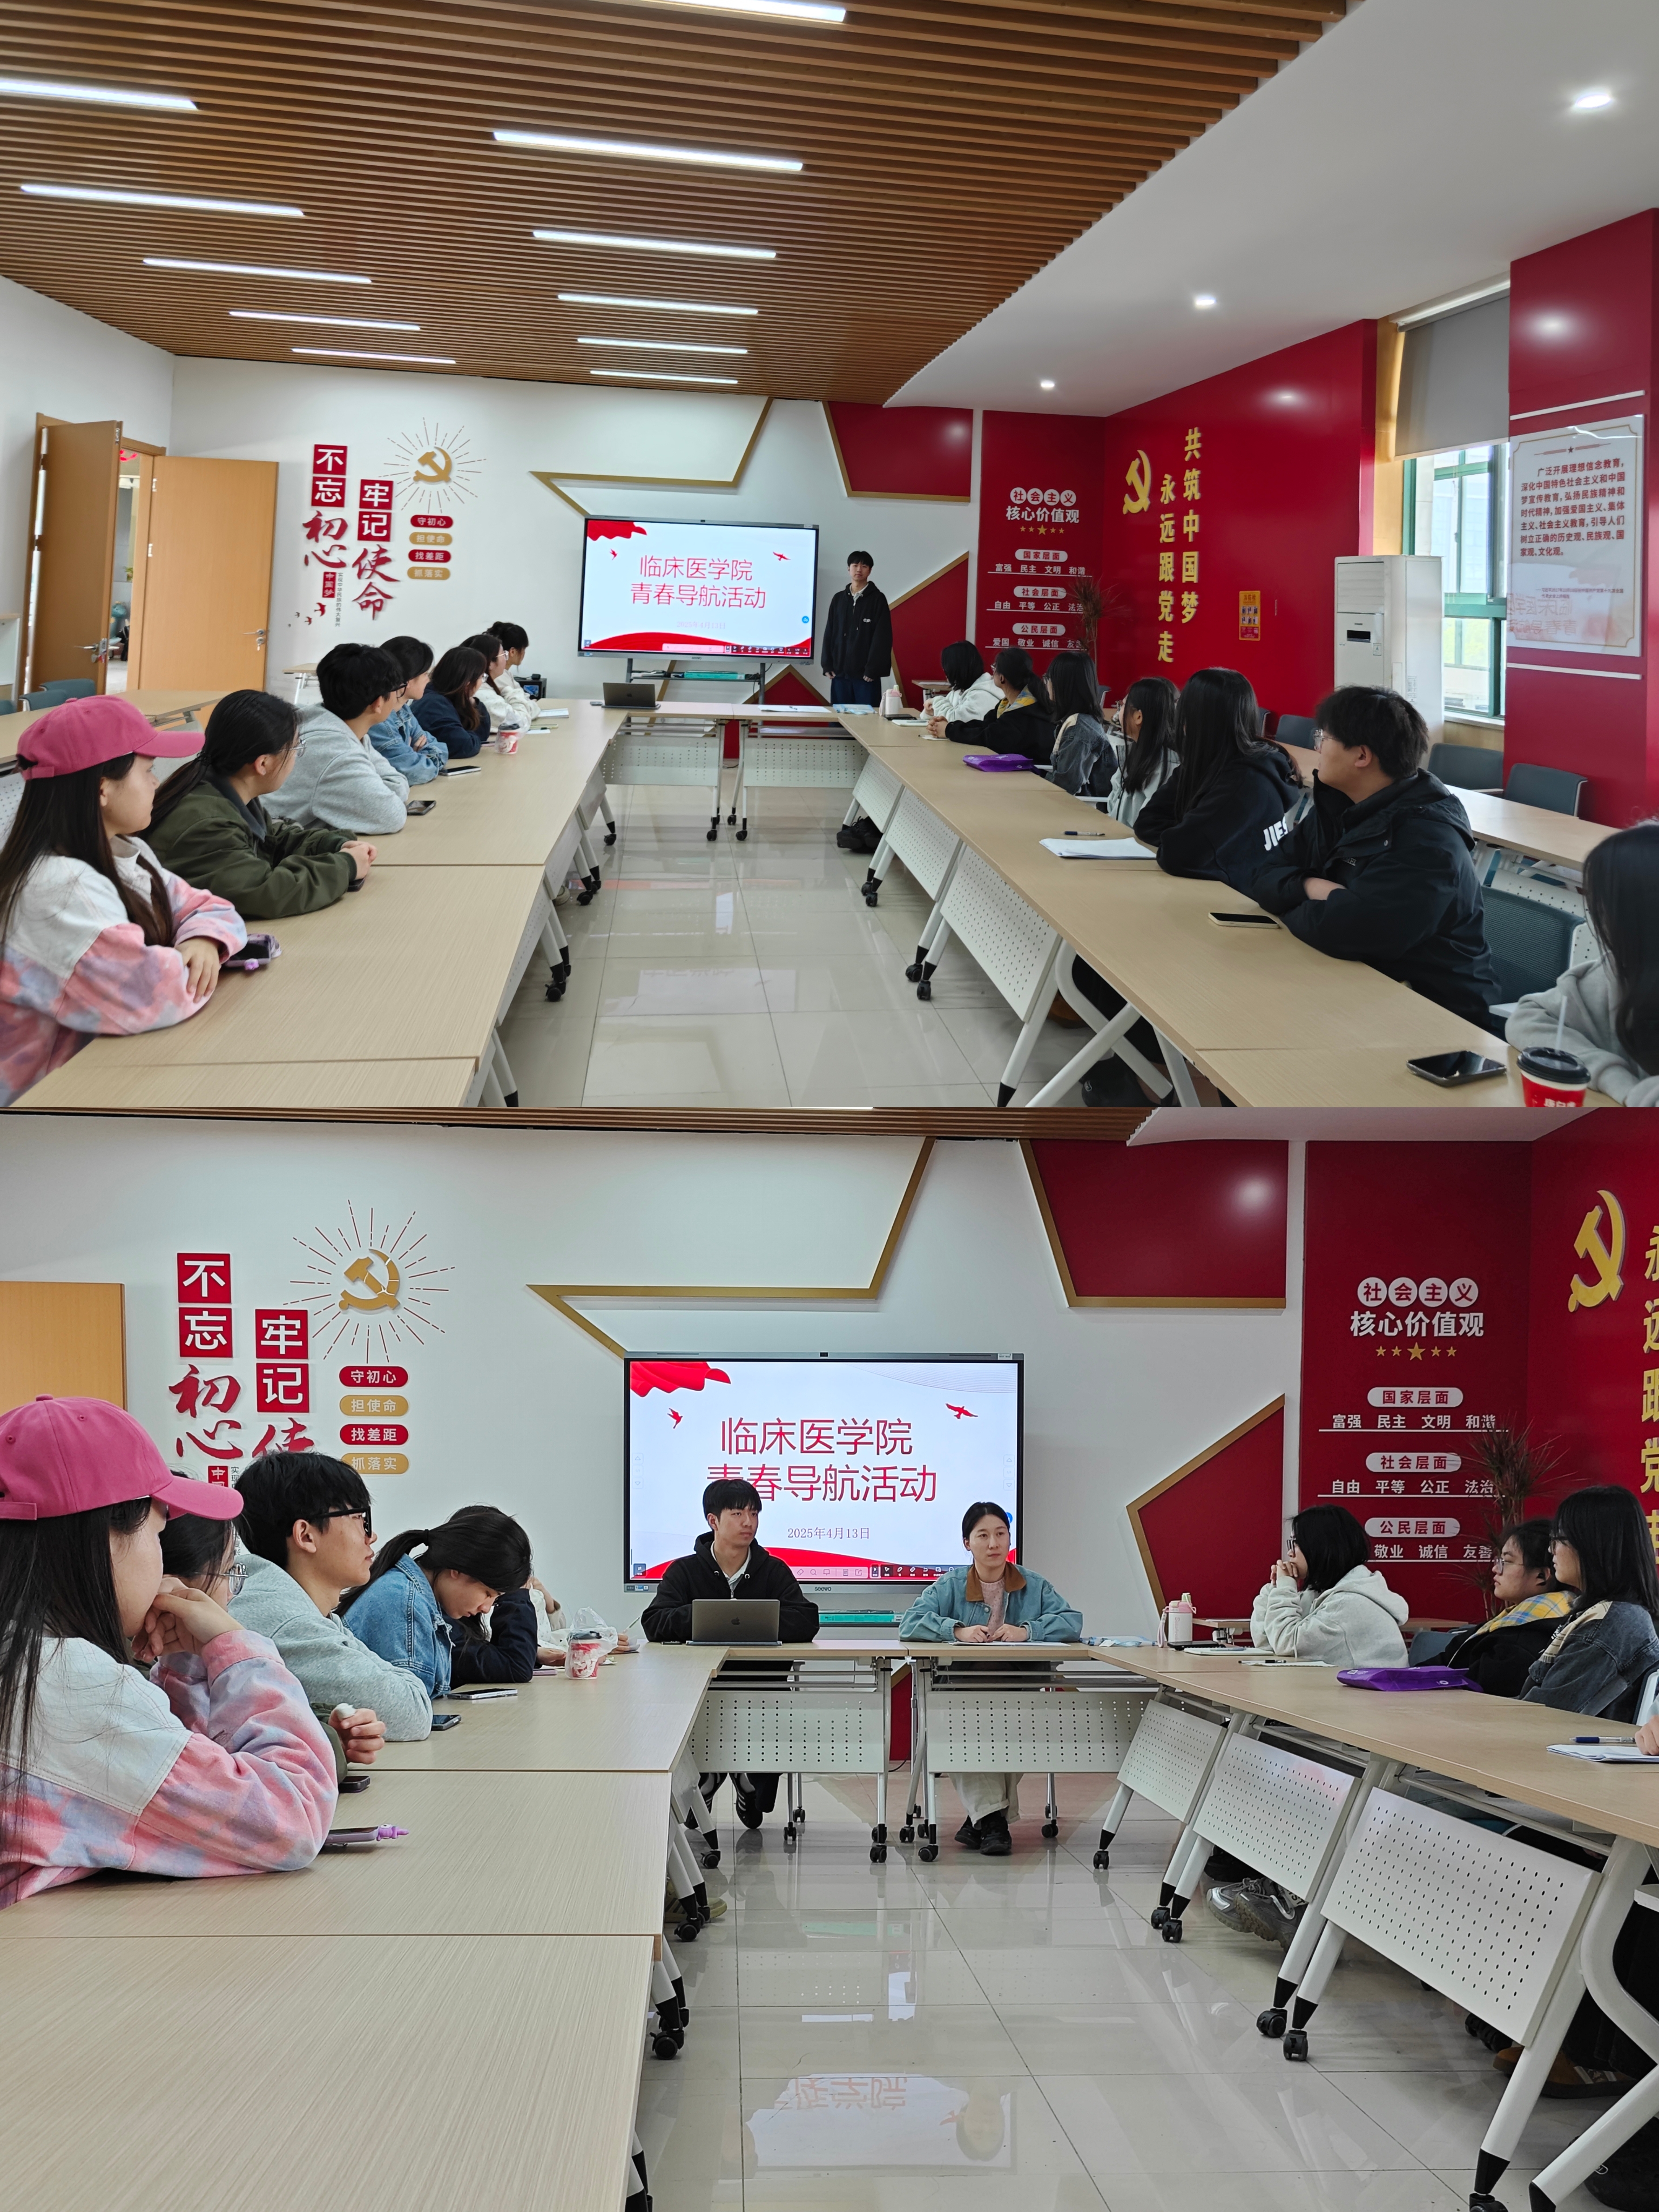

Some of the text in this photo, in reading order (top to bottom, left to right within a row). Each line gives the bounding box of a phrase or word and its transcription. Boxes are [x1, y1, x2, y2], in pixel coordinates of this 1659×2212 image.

[1537, 458, 1624, 477] 广泛开展理想信念教育，
[1521, 472, 1625, 491] 深化中国特色社会主义和中国
[1013, 490, 1074, 504] 社会主义
[1521, 487, 1625, 505] 梦宣传教育，弘扬民族精神和
[302, 448, 348, 569] 不忘初心
[1006, 505, 1080, 523] 核心价值观
[1521, 501, 1625, 517] 时代精神，加强爱国主义、集体
[417, 517, 446, 527] 守初心
[1181, 427, 1203, 624] 共筑中国梦
[1521, 515, 1624, 531] 主义、社会主义教育，引导人们
[416, 534, 446, 544] 担使命
[1520, 530, 1624, 544] 树立正确的历史观、民族观、国
[352, 483, 400, 620] 牢记使命
[415, 551, 444, 561] 找差距
[1023, 551, 1060, 561] 国家层面
[1520, 547, 1563, 557] 家观、文化观。
[414, 569, 443, 579] 抓落实
[639, 555, 753, 581] 临床医学院
[995, 563, 1085, 575] 富强 民主 文明 和谐
[1158, 474, 1176, 663] 永远跟党走
[323, 572, 335, 597] 中国梦
[631, 583, 766, 609] 青春导航活动
[1022, 588, 1058, 597] 社会层面
[994, 601, 1010, 610] 自由
[1019, 602, 1036, 610] 平等
[1044, 602, 1060, 611] 公正
[1021, 625, 1058, 634] 公民层面
[993, 638, 1009, 647] 爱国
[1017, 638, 1034, 647] 敬业
[1042, 639, 1059, 648] 诚信
[1363, 1282, 1474, 1303] 社会主义
[1350, 1311, 1484, 1337] 核心价值观
[168, 1260, 243, 1460] 不忘初心
[350, 1371, 397, 1384] 守初心
[1382, 1390, 1449, 1405] 国家层面
[351, 1399, 397, 1413] 担使命
[1333, 1414, 1362, 1429] 富强
[1377, 1415, 1406, 1429] 民主
[1421, 1415, 1451, 1429] 文明
[351, 1428, 397, 1441] 找差距
[721, 1417, 914, 1456] 临床医学院
[351, 1456, 397, 1471] 抓落实
[1380, 1455, 1447, 1469] 社会层面
[1332, 1479, 1494, 1494] 自由 平等 公正 法治
[787, 1527, 870, 1540] 2025年4月13日
[1380, 1520, 1446, 1535] 公民层面
[1374, 1544, 1493, 1559] 敬业 诚信 友善
